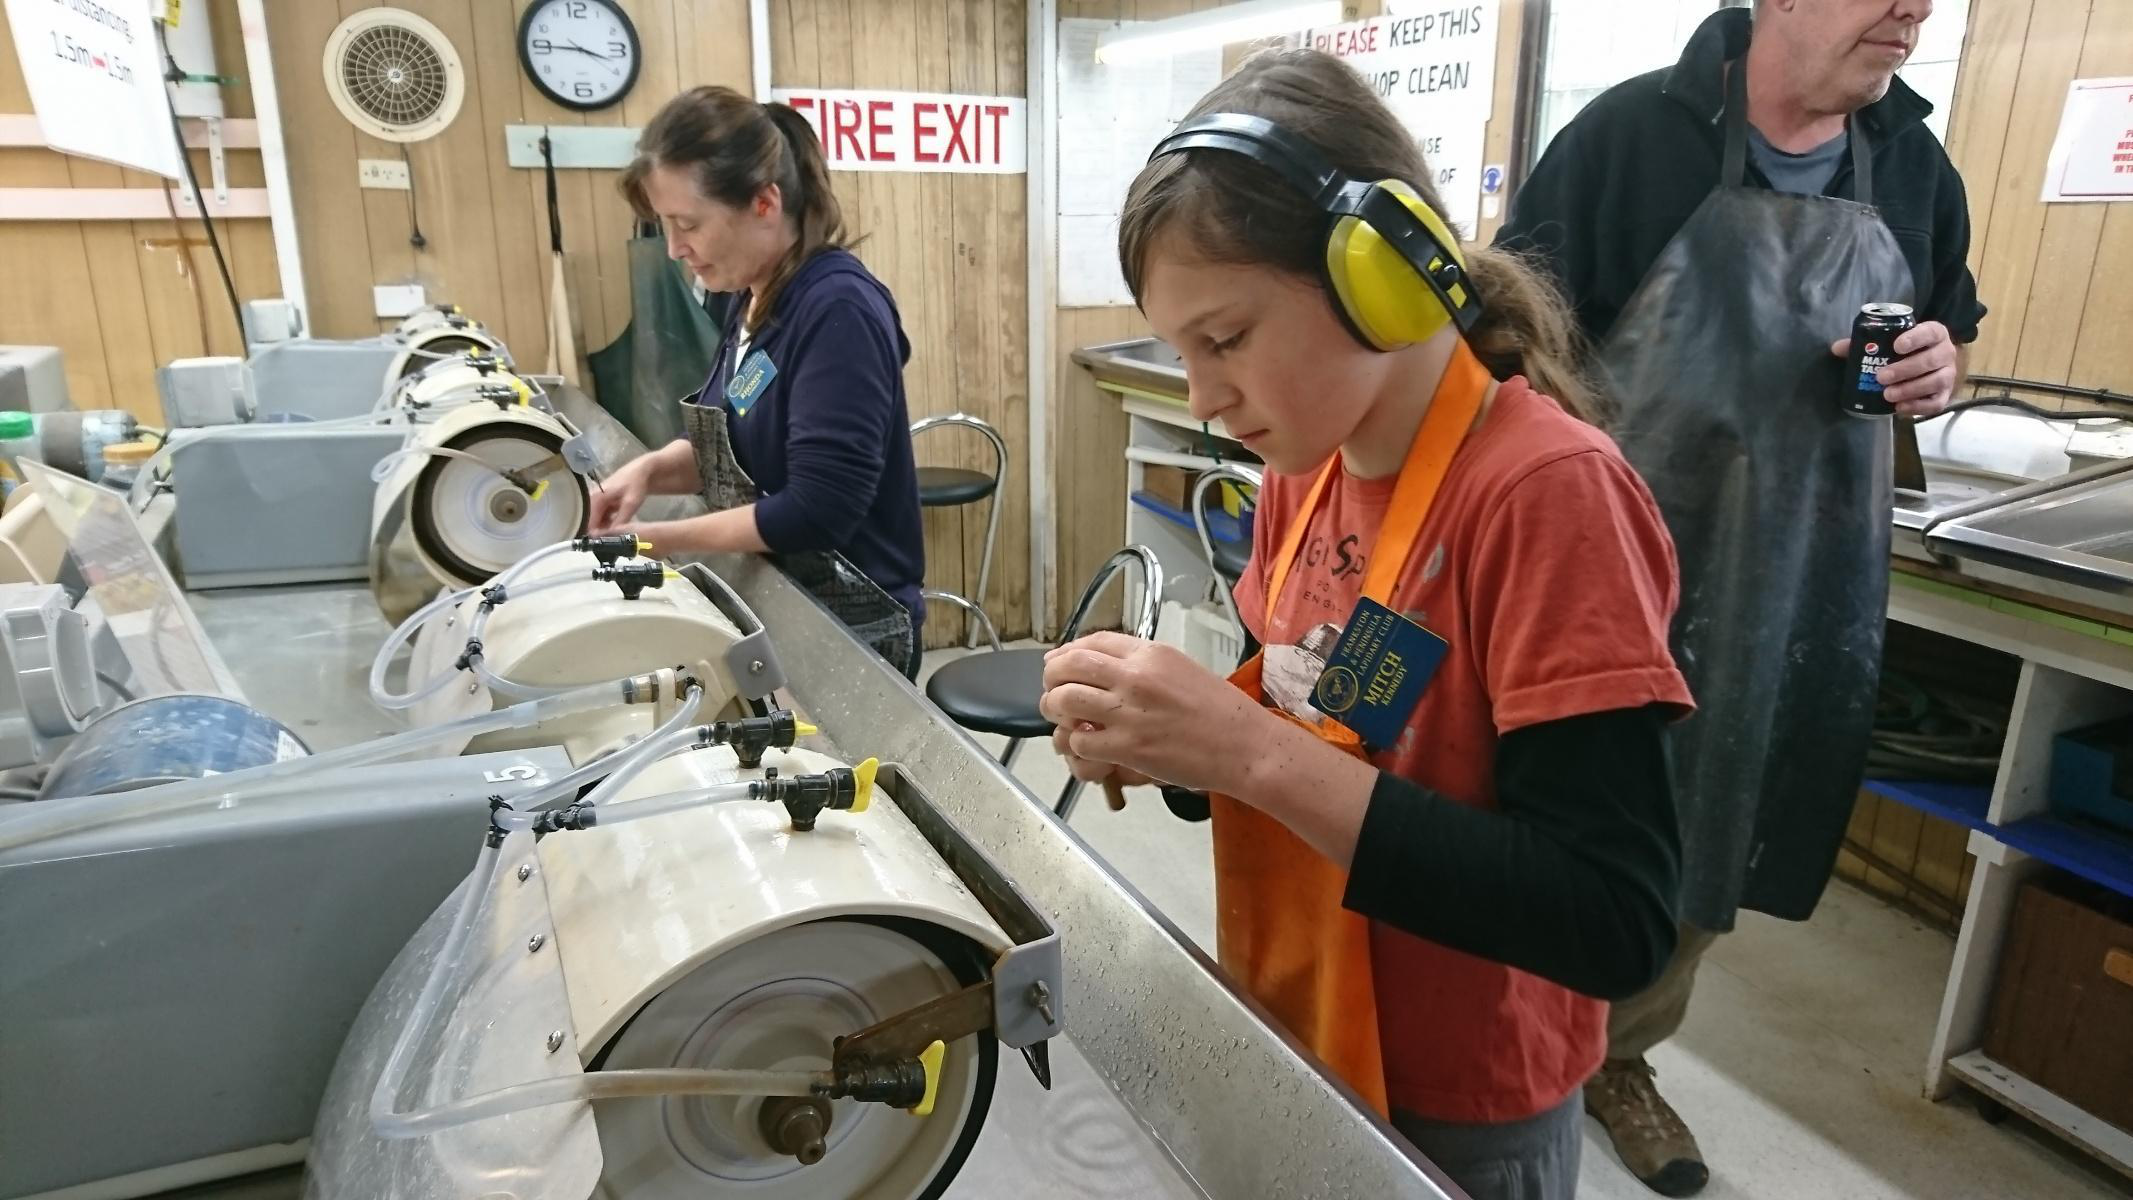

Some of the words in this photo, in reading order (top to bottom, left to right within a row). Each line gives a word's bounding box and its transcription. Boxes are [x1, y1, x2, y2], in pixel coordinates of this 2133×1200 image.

[565, 2, 587, 19] 12
[538, 24, 549, 33] 10
[1389, 15, 1434, 48] KEEP
[1438, 5, 1483, 39] THIS
[532, 39, 552, 55] 9
[607, 41, 627, 59] 3
[1408, 61, 1470, 94] CLEAN
[573, 82, 594, 98] 6
[913, 103, 1010, 165] EXIT
[1439, 168, 1457, 184] OF
[1860, 365, 1882, 374] TAS
[1861, 355, 1889, 366] MAX
[1341, 610, 1371, 657] FRANKSTON
[1355, 614, 1382, 658] PENINSULA
[1358, 636, 1383, 677] LAPIDARY
[1378, 614, 1395, 637] CLUB
[1363, 651, 1402, 706] MITCH
[1381, 665, 1408, 706] KENNEDY
[483, 765, 537, 783] 5
